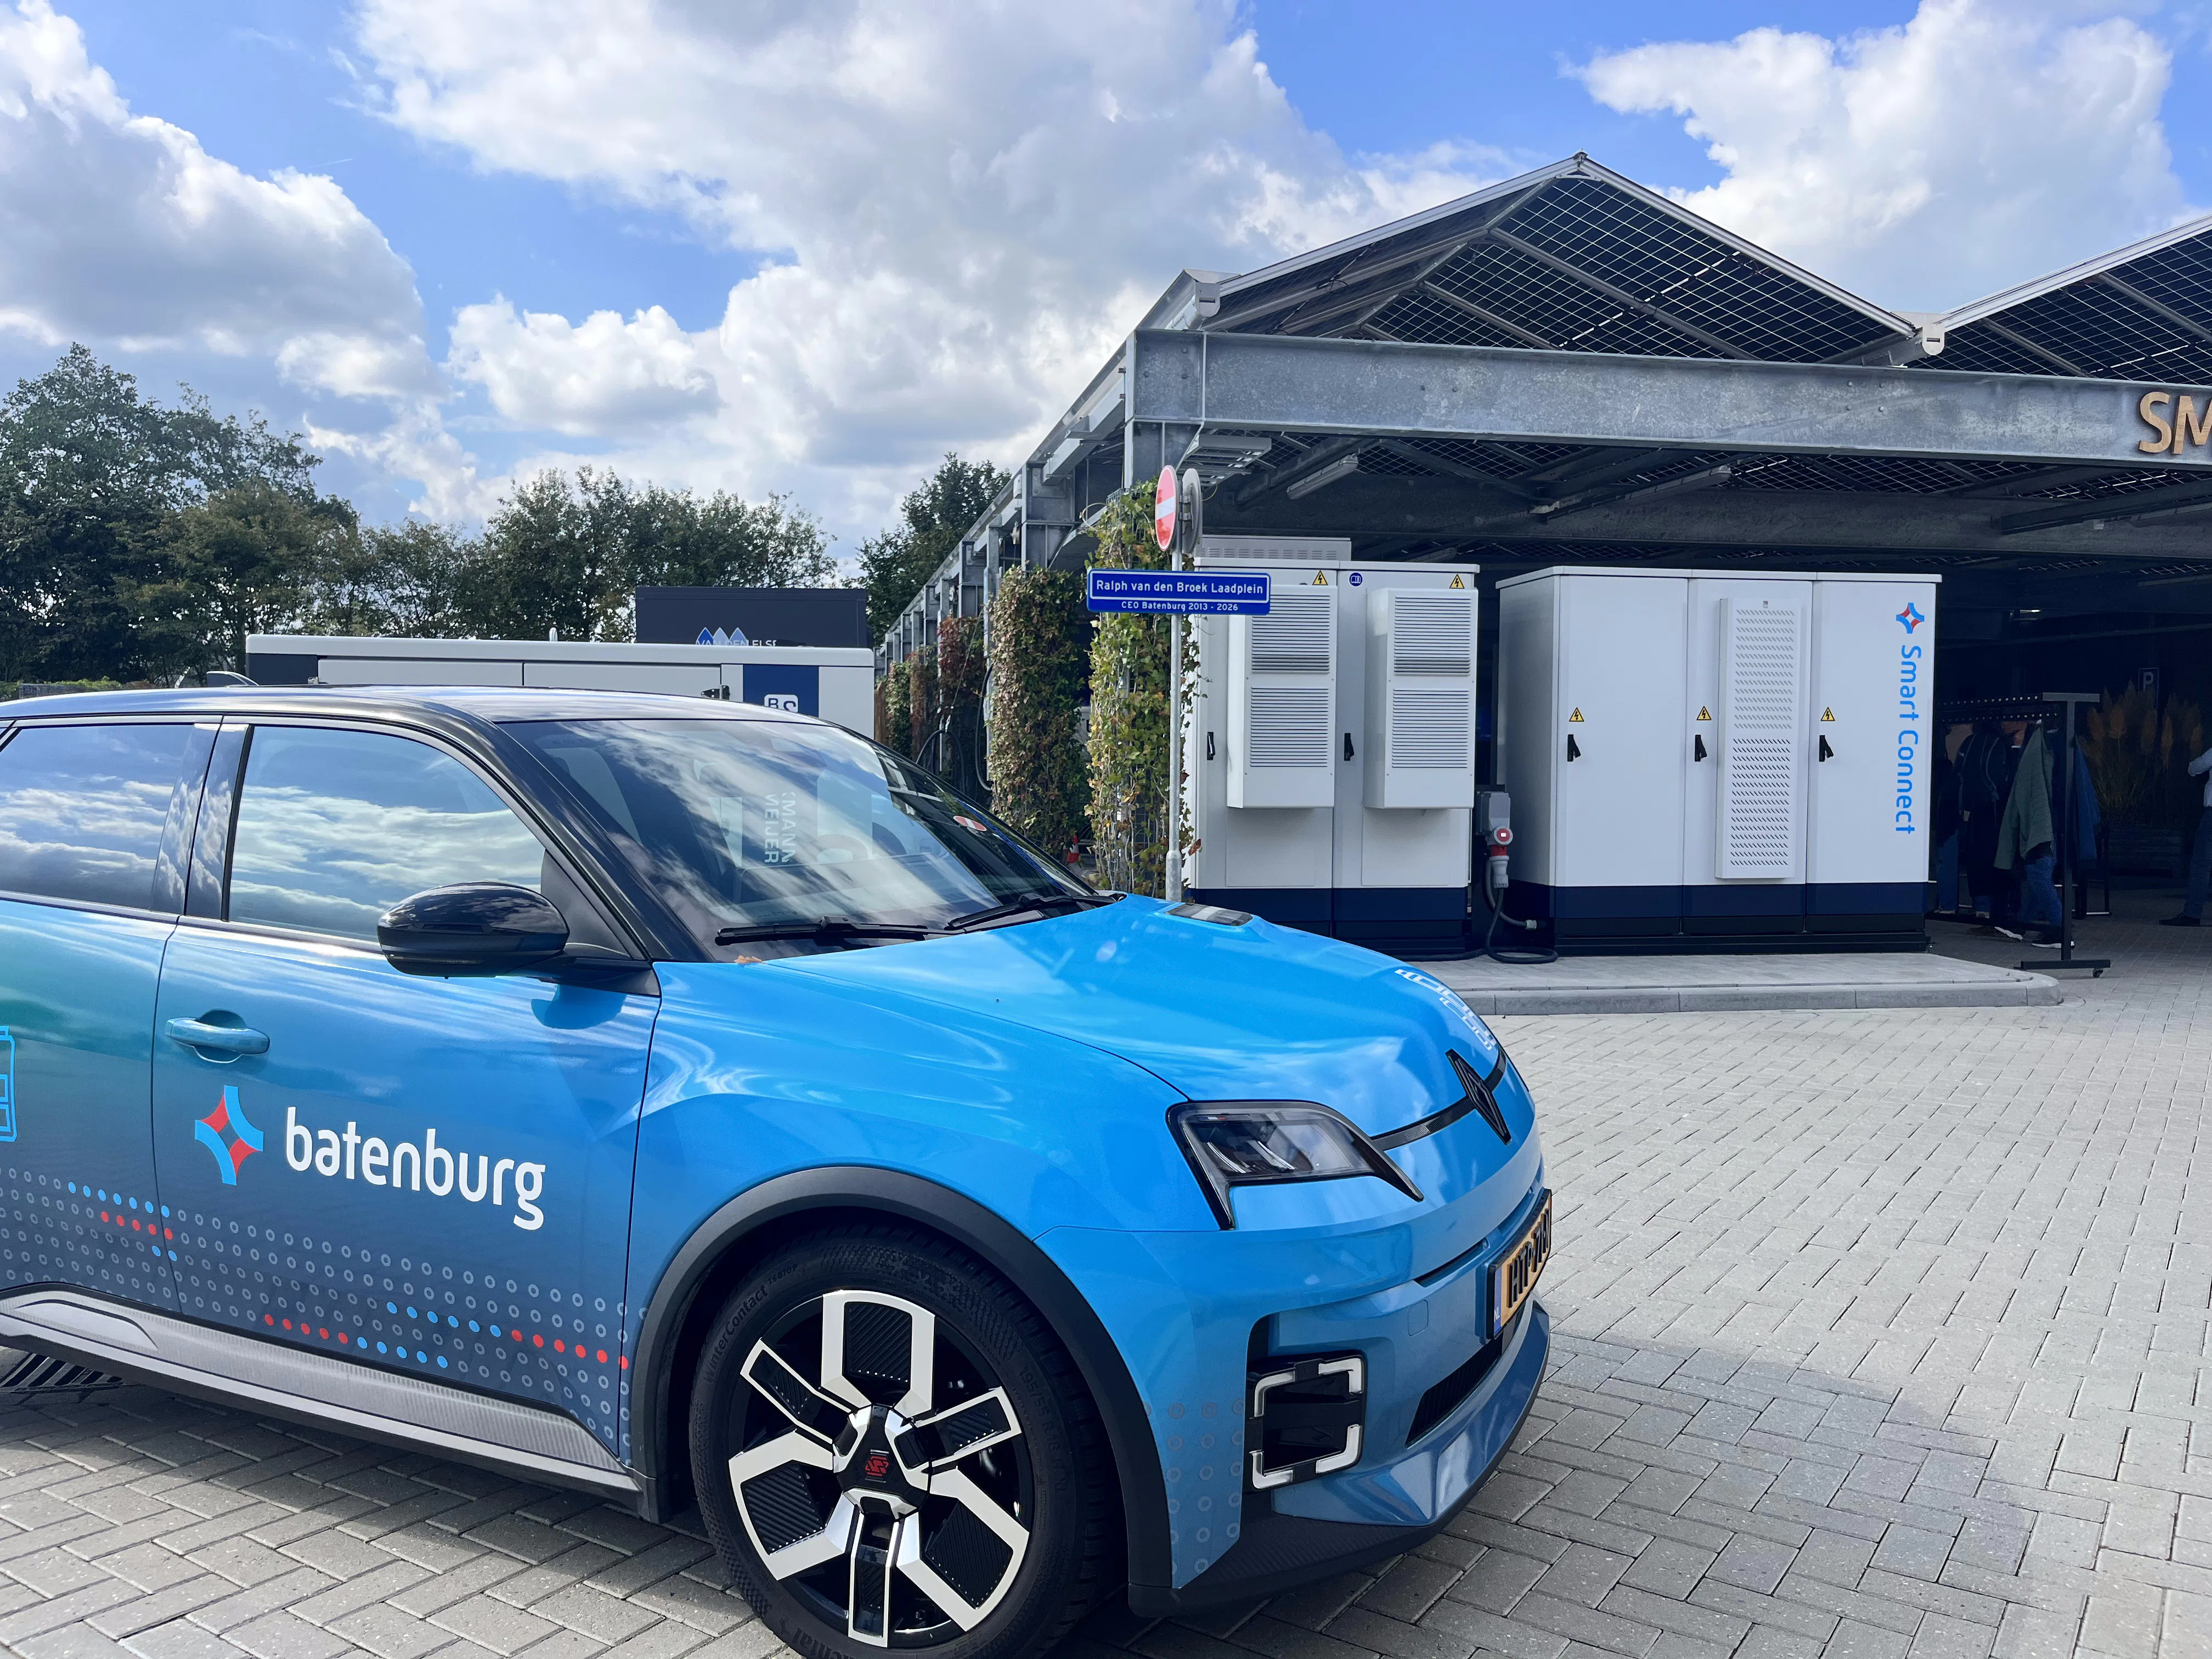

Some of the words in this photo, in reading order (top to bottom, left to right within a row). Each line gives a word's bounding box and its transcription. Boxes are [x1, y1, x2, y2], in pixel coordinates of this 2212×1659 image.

[2139, 391, 2212, 454] SM
[1097, 580, 1127, 593] Ralph
[1131, 583, 1150, 591] van
[1154, 581, 1173, 592] den
[1177, 582, 1207, 593] Broek
[1211, 583, 1263, 595] Laadplein
[1142, 602, 1186, 612] Batenburg
[1899, 644, 1922, 721] Smart
[2143, 672, 2154, 691] P
[1895, 730, 1918, 834] Connect
[285, 1106, 546, 1231] batenburg
[703, 1283, 769, 1383] WinterContact
